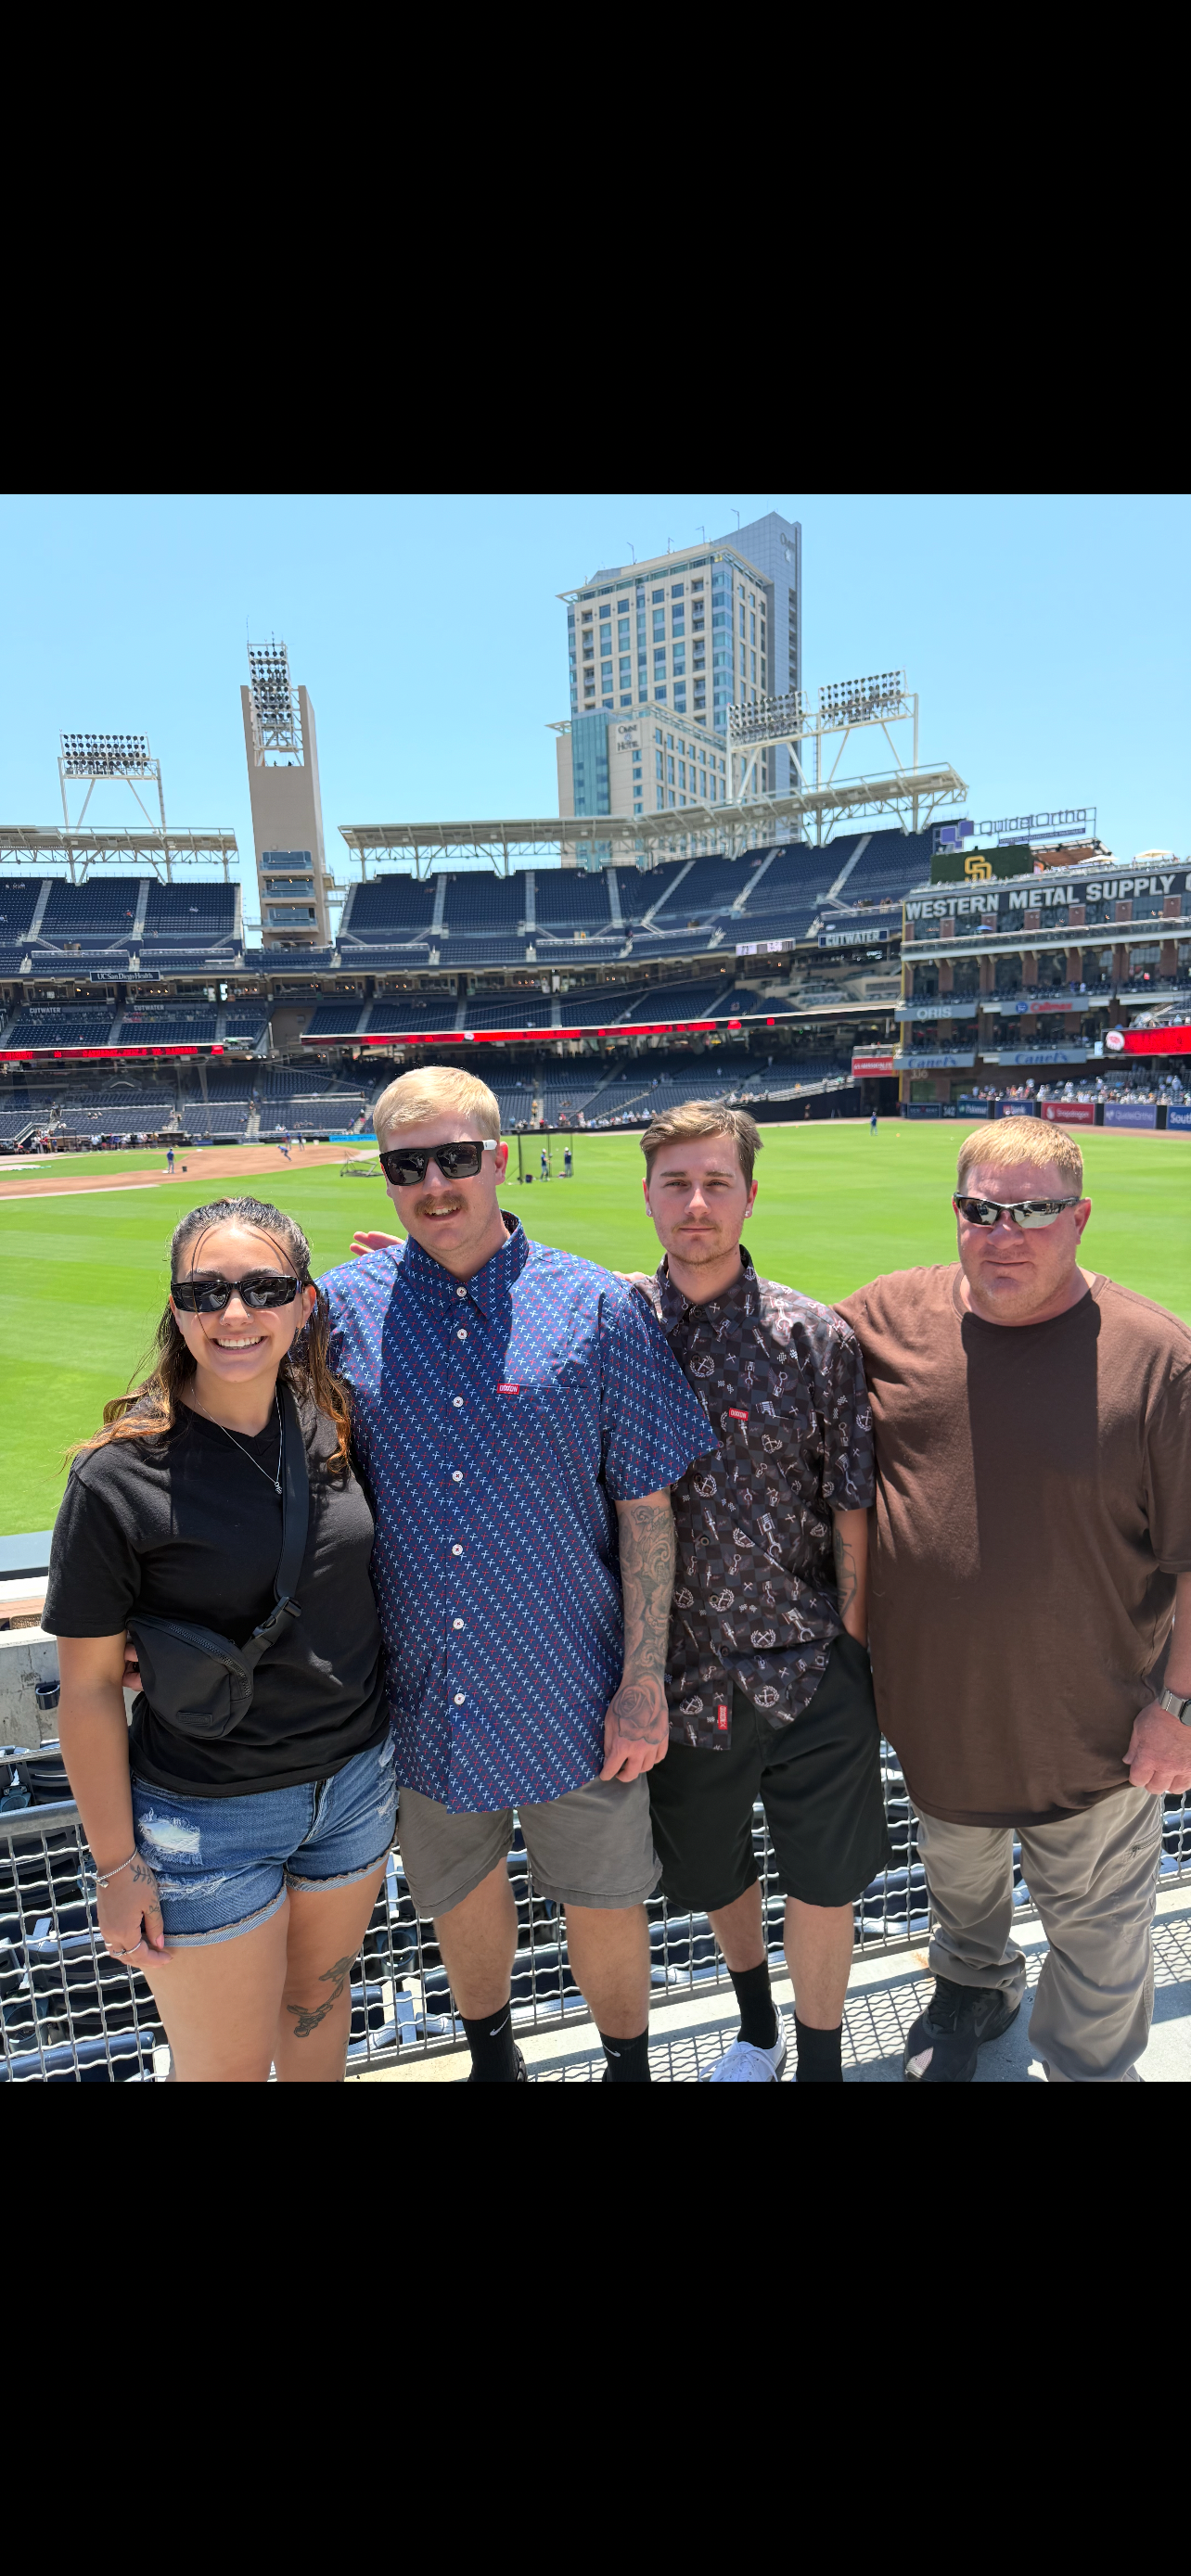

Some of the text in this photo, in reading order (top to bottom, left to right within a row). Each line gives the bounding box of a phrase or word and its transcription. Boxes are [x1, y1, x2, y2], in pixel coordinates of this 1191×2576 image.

[980, 808, 1086, 835] QuidelOrtho
[905, 893, 999, 920] WESTERN
[1009, 886, 1080, 910] METAL
[1086, 874, 1175, 901] SUPPLY
[826, 931, 879, 946] CUTWATER
[916, 1006, 952, 1020] ORIS
[1015, 1051, 1069, 1065] Canel's
[1057, 1108, 1090, 1120] Snapdragon
[1171, 1112, 1191, 1124] Sout
